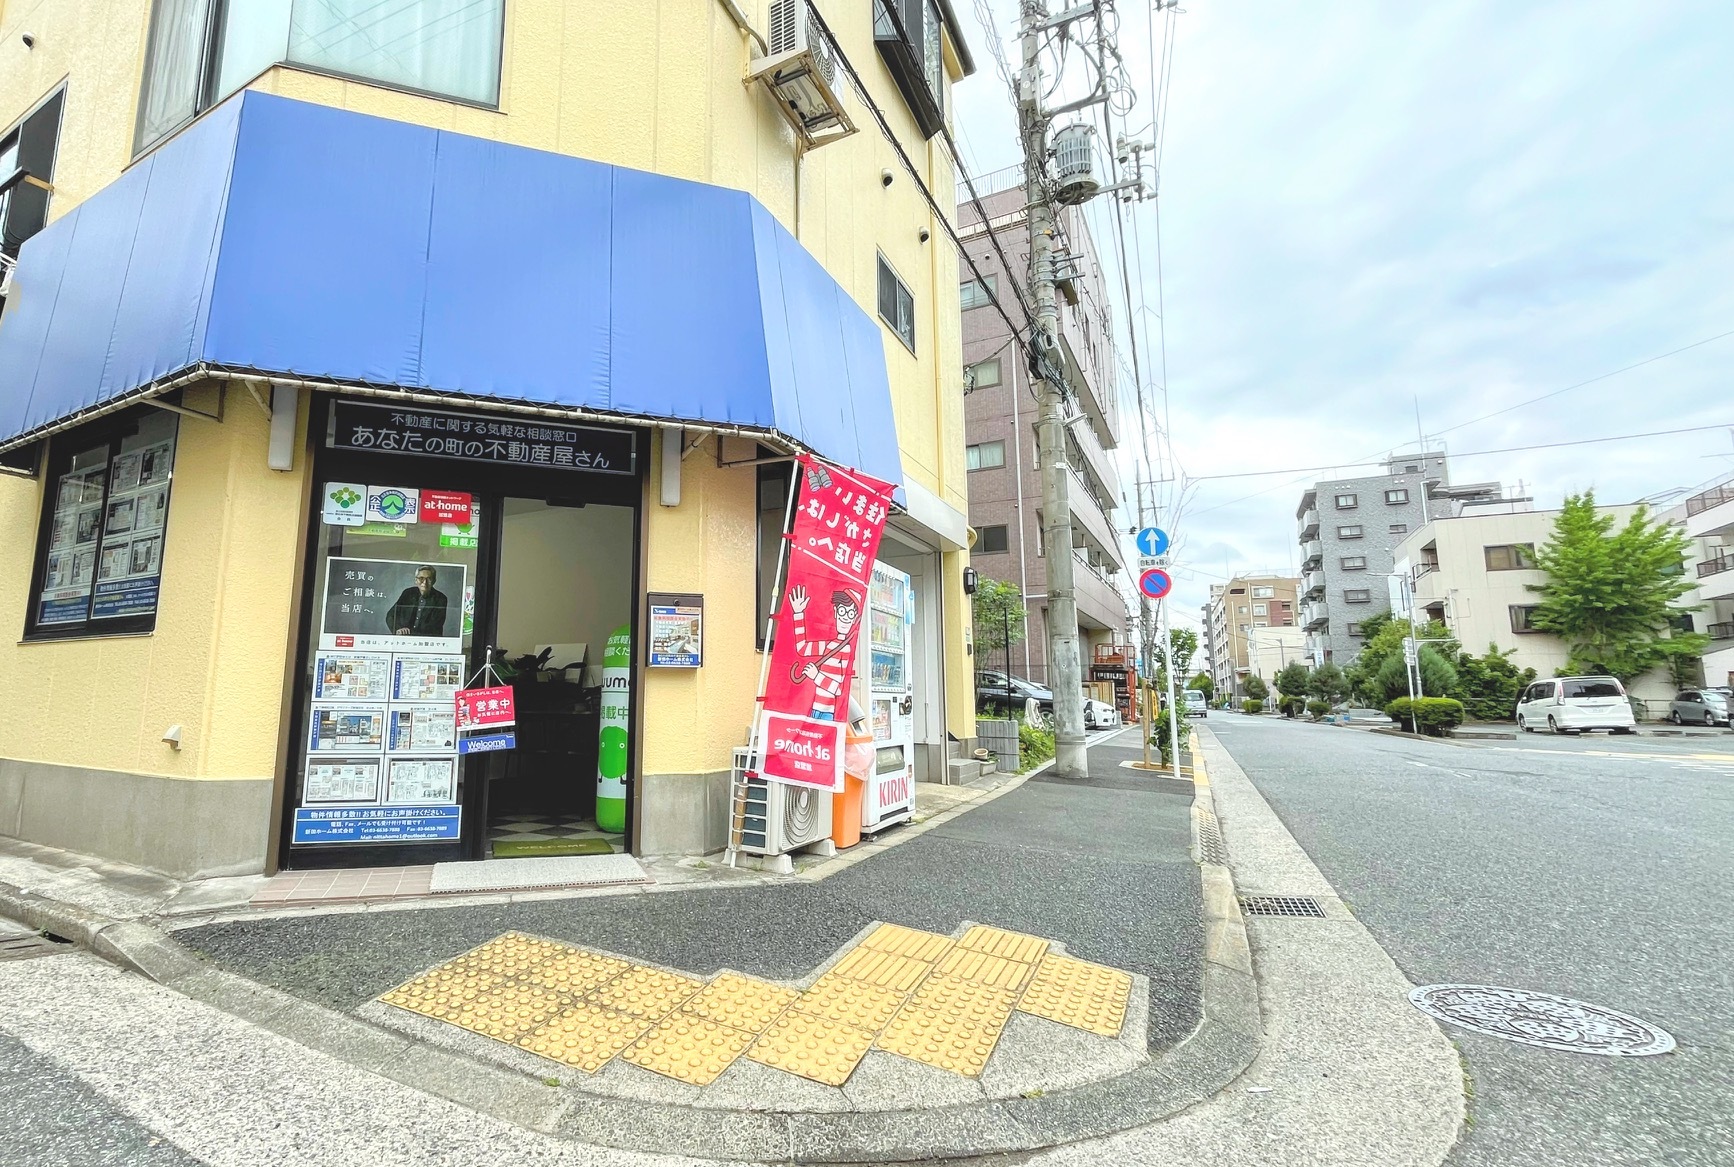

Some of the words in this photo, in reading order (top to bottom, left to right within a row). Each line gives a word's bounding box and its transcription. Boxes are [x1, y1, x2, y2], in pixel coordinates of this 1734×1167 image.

[391, 412, 577, 443] 不動産に関する気軽な相談窓口
[351, 425, 610, 469] あなたの町の不動産屋さん
[424, 500, 436, 509] at
[436, 499, 468, 512] home
[1139, 558, 1168, 567] 自転車を除く
[344, 570, 374, 582] 売買の
[342, 587, 387, 598] ご相談は、
[340, 603, 374, 614] 当店へ。
[475, 697, 511, 712] 営業中
[467, 739, 506, 750] Welcome
[879, 775, 909, 808] KIRIN
